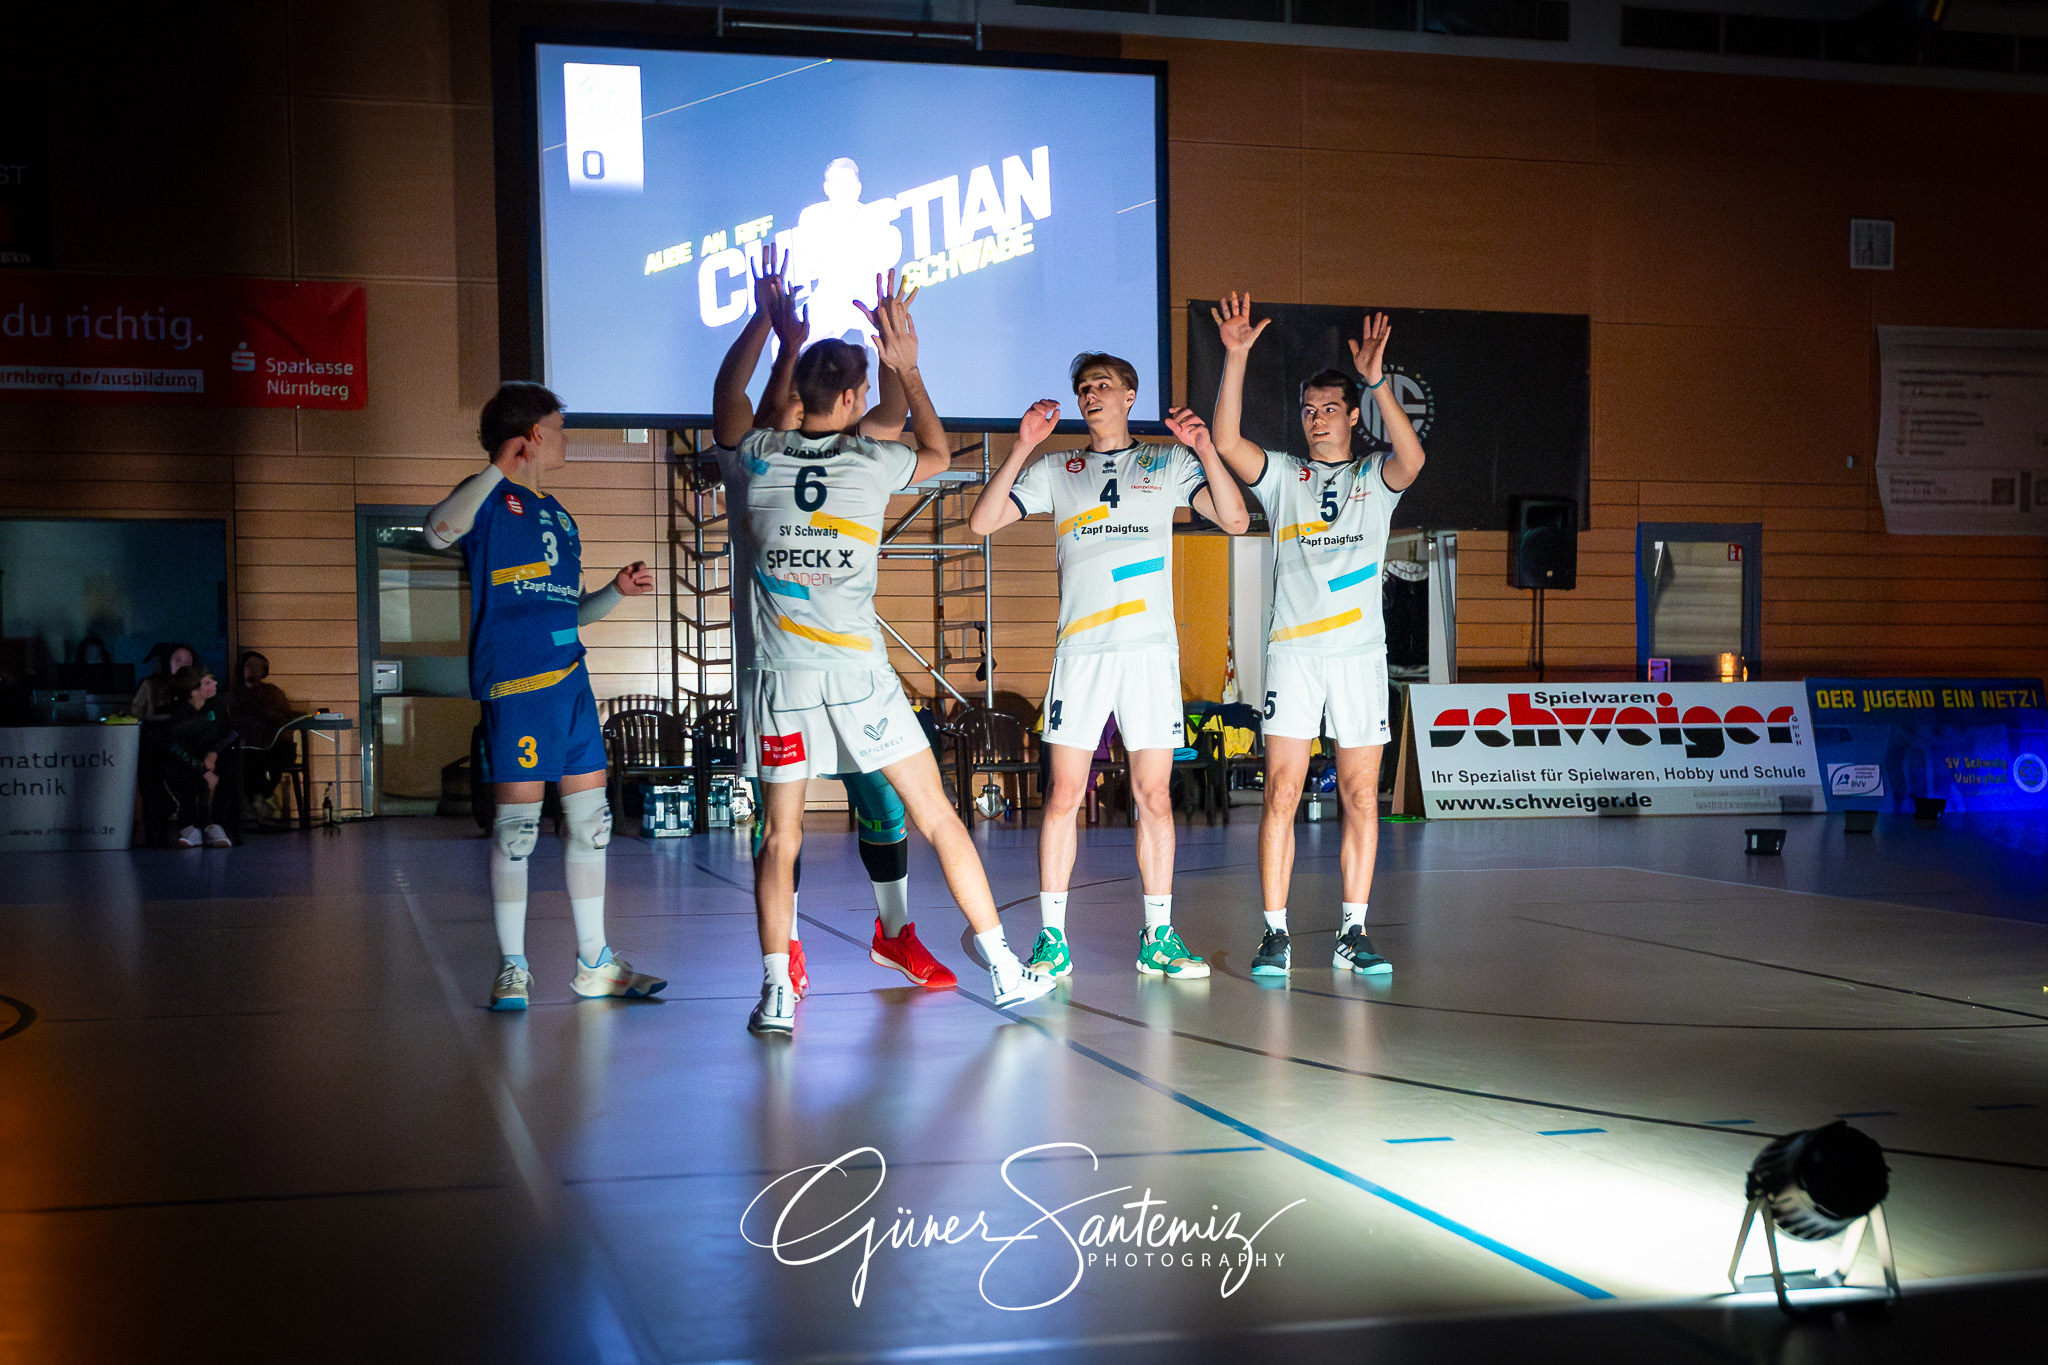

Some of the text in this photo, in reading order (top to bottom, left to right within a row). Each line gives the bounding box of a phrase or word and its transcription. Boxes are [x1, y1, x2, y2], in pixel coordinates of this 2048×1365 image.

[582, 150, 606, 180] 0
[900, 222, 1035, 294] SCHWABE
[2, 302, 205, 351] du richtig.
[265, 357, 354, 377] Sparkasse
[267, 380, 349, 401] Nürnberg
[794, 465, 828, 513] 6
[1099, 477, 1120, 509] 4
[1320, 490, 1339, 523] 5
[779, 525, 839, 540] SV Schwaig
[1080, 523, 1150, 536] Zapf Daigfuss
[1323, 533, 1364, 546] Daigfuss
[542, 531, 559, 567] 3
[766, 549, 832, 569] SPECK
[1263, 690, 1278, 721] 5
[1534, 691, 1656, 707] Spielwaren
[1816, 689, 2039, 713] DER JUGEND EIN NETZ!
[1049, 699, 1063, 731] 4
[1429, 691, 1795, 759] schweiger
[517, 735, 539, 769] 3
[1431, 764, 1807, 786] Ihr Spezialist für Spielwaren, Hobby und Schule
[1436, 792, 1653, 813] www.schweiger.de
